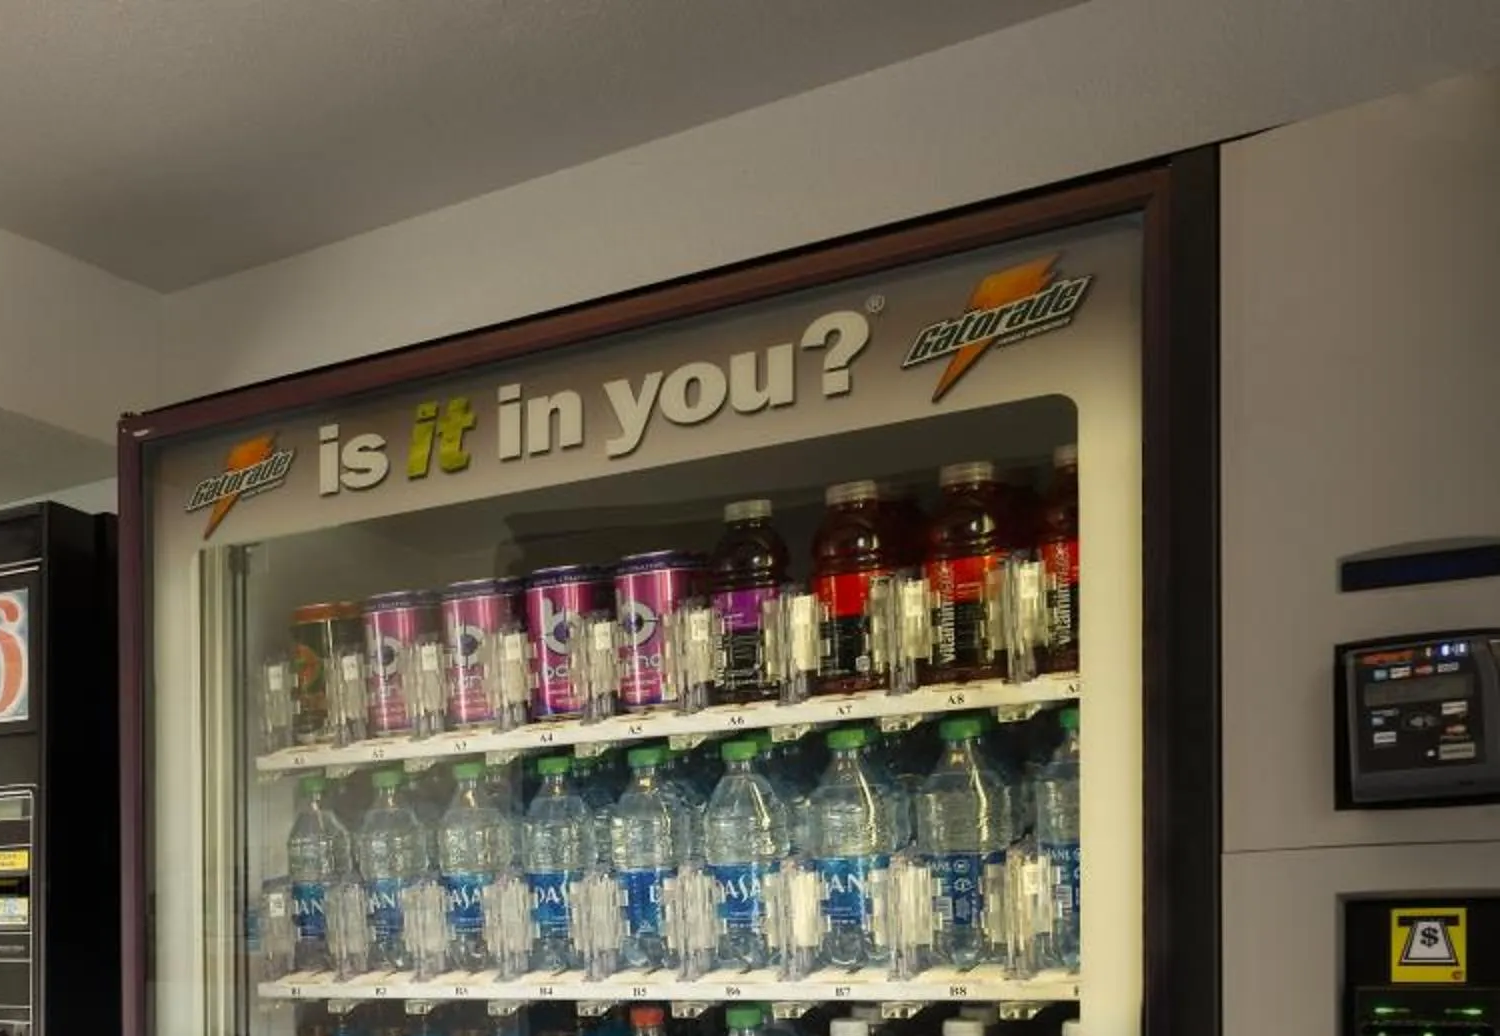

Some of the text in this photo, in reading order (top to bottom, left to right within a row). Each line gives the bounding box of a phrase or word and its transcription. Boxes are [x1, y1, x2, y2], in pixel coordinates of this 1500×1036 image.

[906, 277, 1088, 364] Gatorade
[318, 310, 871, 497] is it in you?
[190, 450, 293, 508] Gatorade
